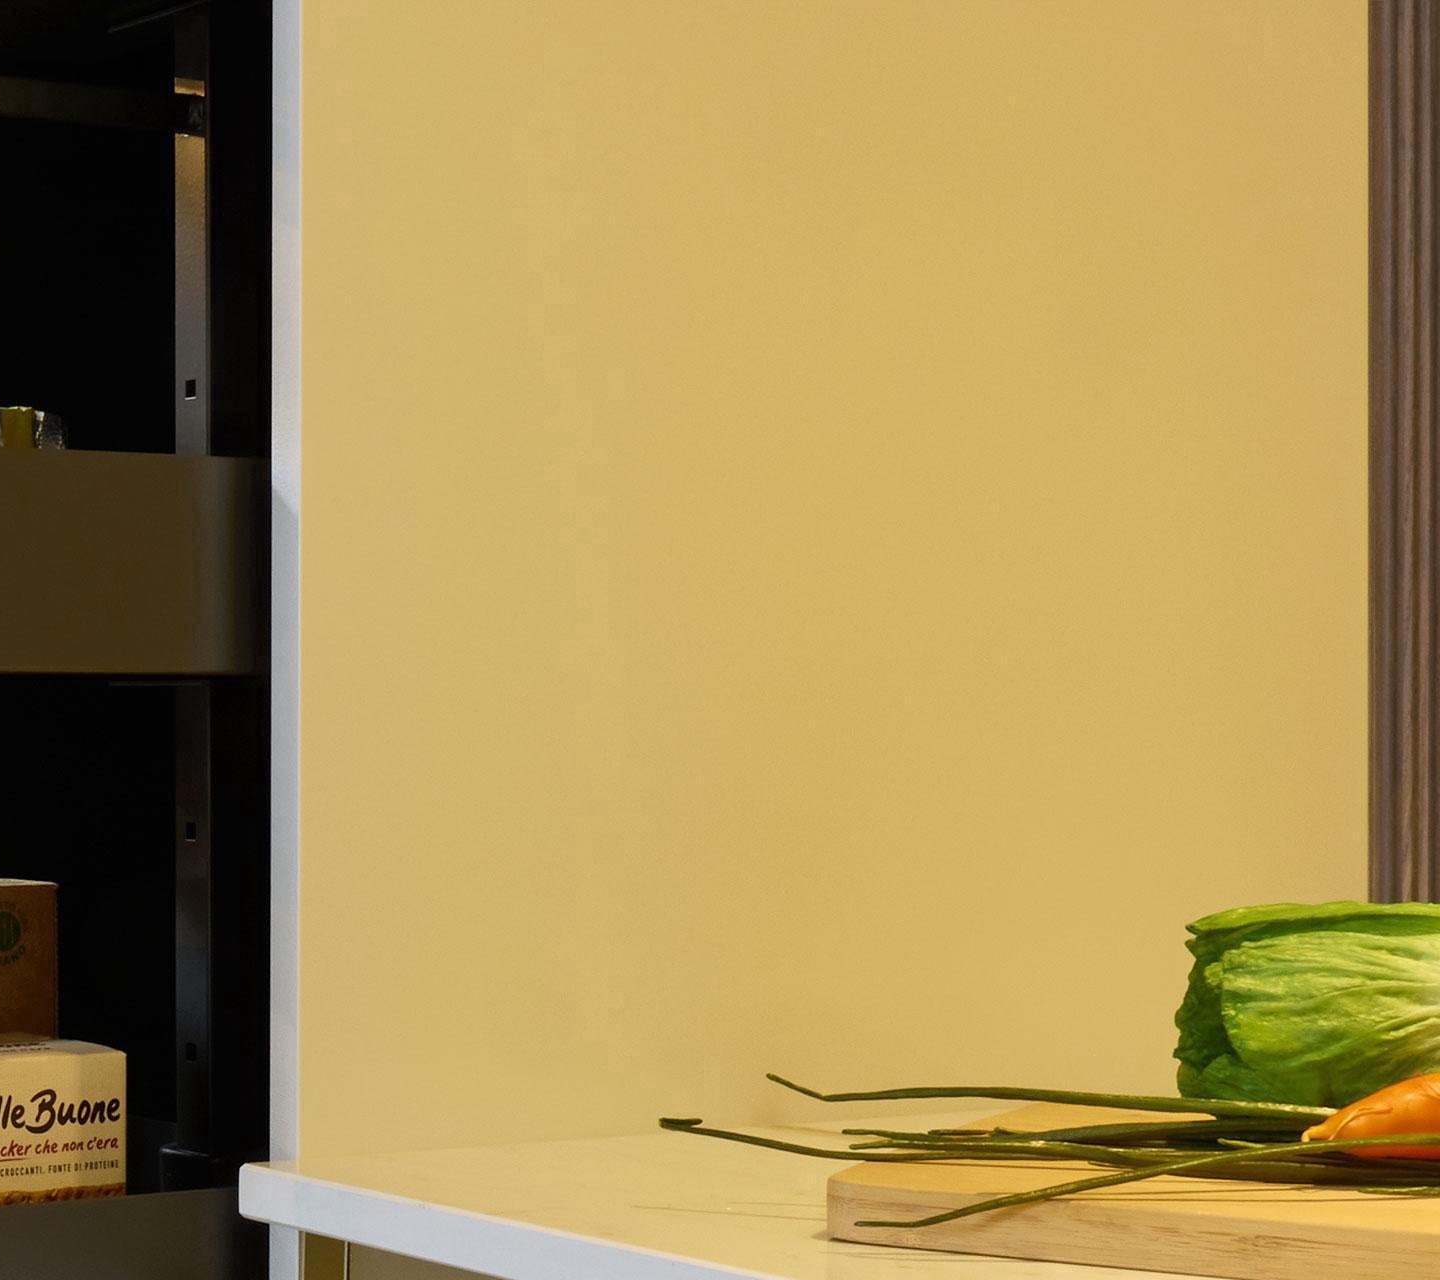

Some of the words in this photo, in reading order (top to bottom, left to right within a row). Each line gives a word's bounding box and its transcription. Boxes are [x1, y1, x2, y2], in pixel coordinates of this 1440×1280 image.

[24, 1088, 122, 1134] Buone
[35, 1139, 58, 1155] che
[61, 1141, 84, 1153] non
[87, 1136, 119, 1151] c'era
[48, 1163, 71, 1175] FONTE
[74, 1162, 83, 1172] DI
[84, 1159, 120, 1171] PROTEINE
